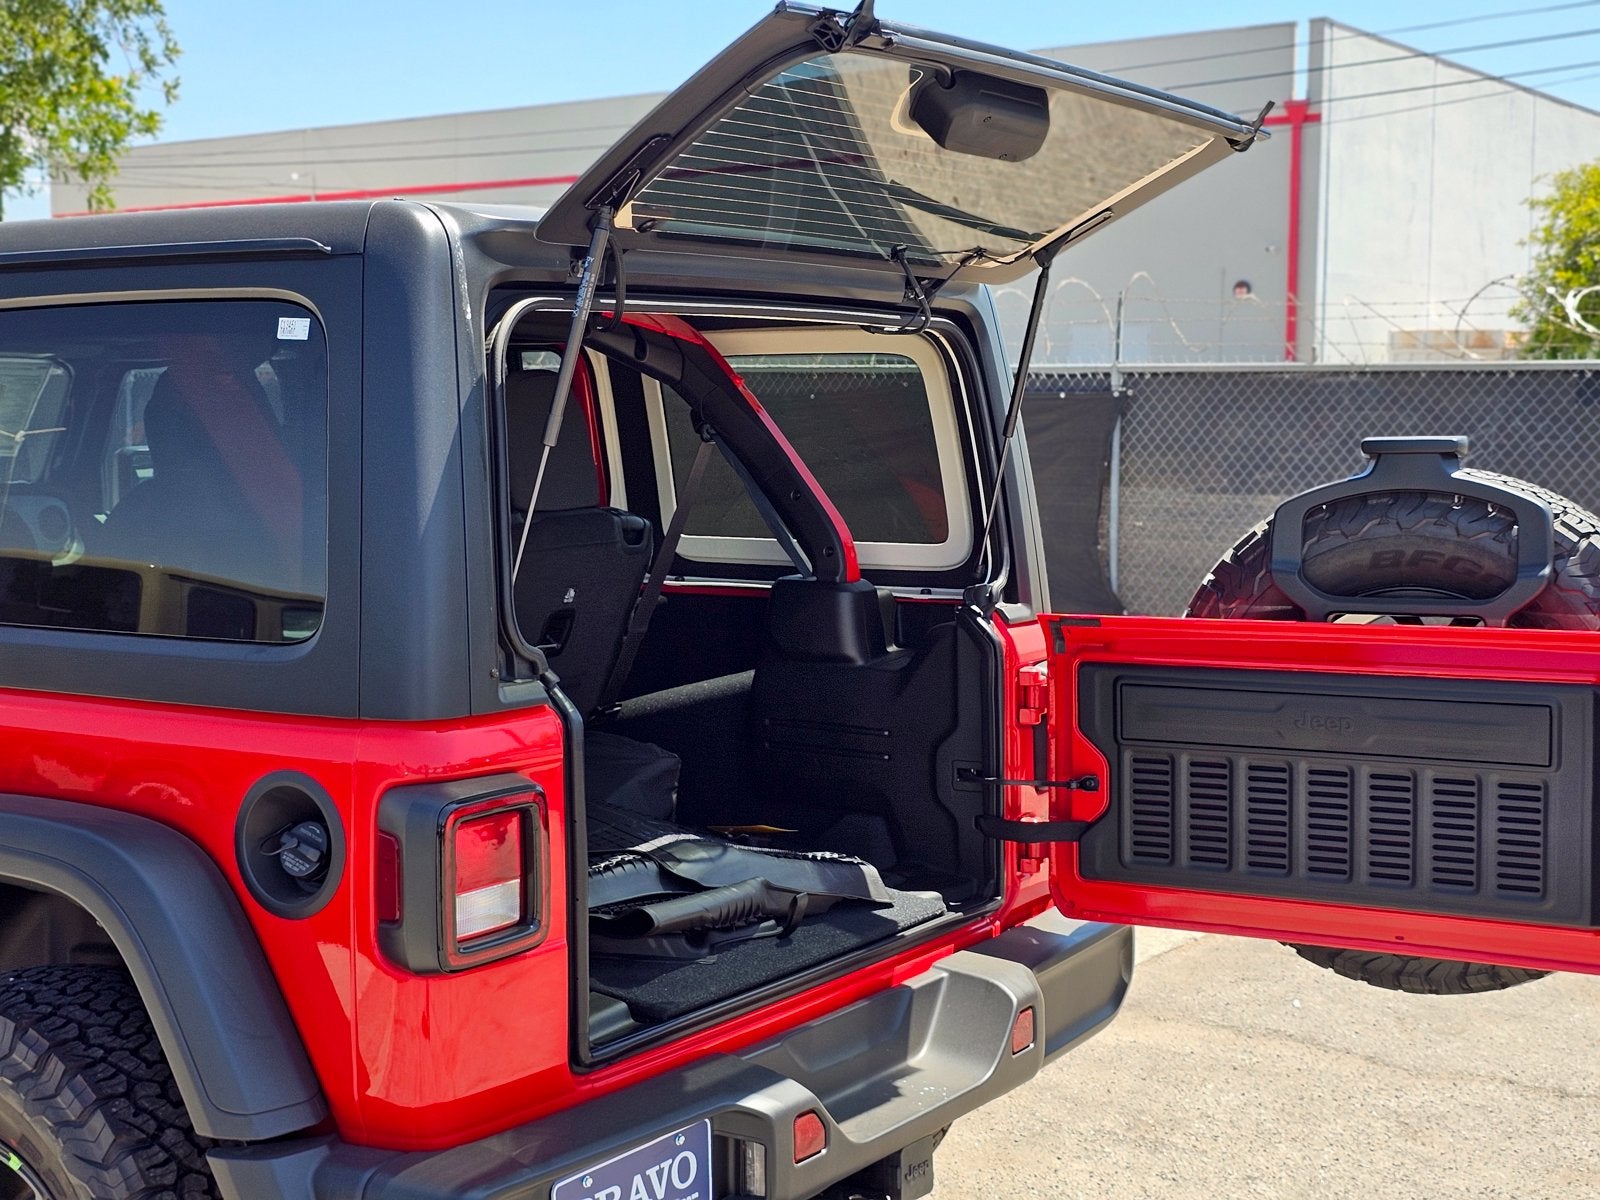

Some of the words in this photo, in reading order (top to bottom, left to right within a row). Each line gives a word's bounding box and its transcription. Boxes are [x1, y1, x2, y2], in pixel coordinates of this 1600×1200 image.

[1294, 710, 1355, 736] Jeep
[581, 1150, 698, 1200] AVO
[904, 1160, 929, 1181] Jeep
